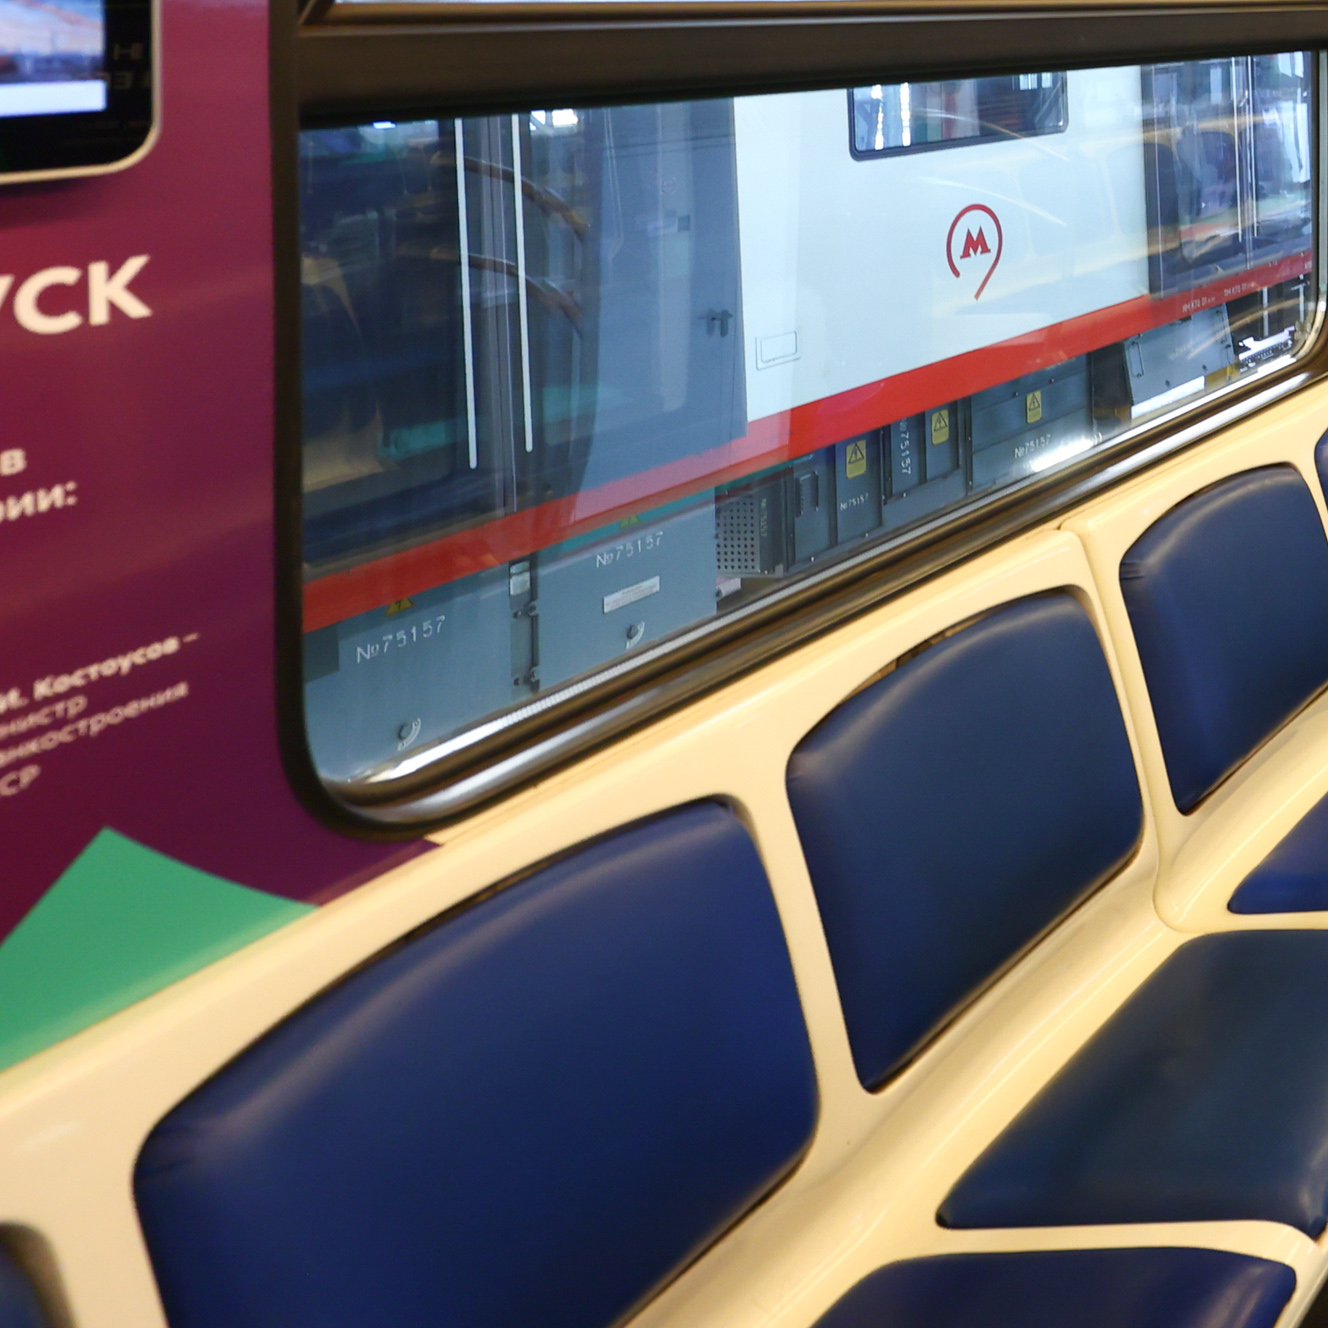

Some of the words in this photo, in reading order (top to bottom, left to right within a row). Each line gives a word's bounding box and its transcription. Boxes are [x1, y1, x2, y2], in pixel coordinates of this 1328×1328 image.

[0, 254, 153, 335] СК
[0, 481, 78, 521] ии:
[596, 531, 664, 569] №75157
[356, 615, 446, 664] №75157
[33, 635, 180, 701] Костоусов
